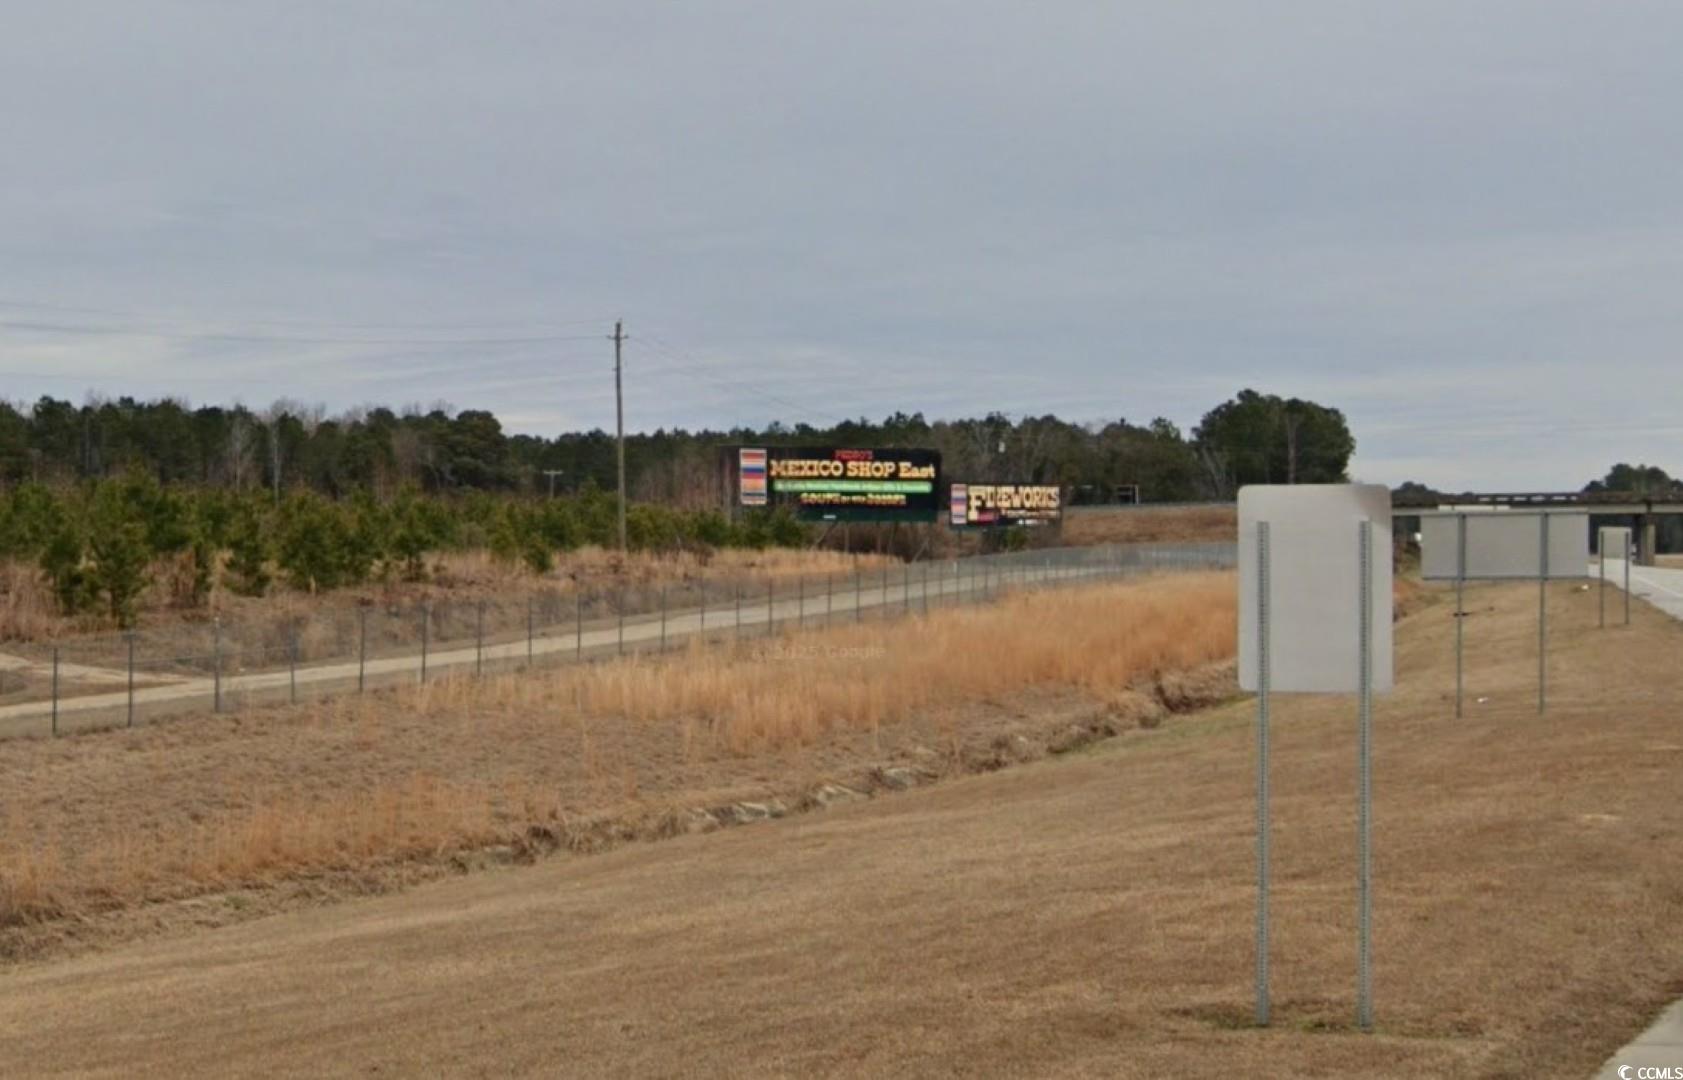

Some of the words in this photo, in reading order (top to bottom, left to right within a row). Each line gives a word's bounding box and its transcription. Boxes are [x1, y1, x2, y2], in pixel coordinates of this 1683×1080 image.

[769, 459, 844, 477] MEXICO
[846, 461, 896, 477] SHOP
[899, 462, 935, 478] East
